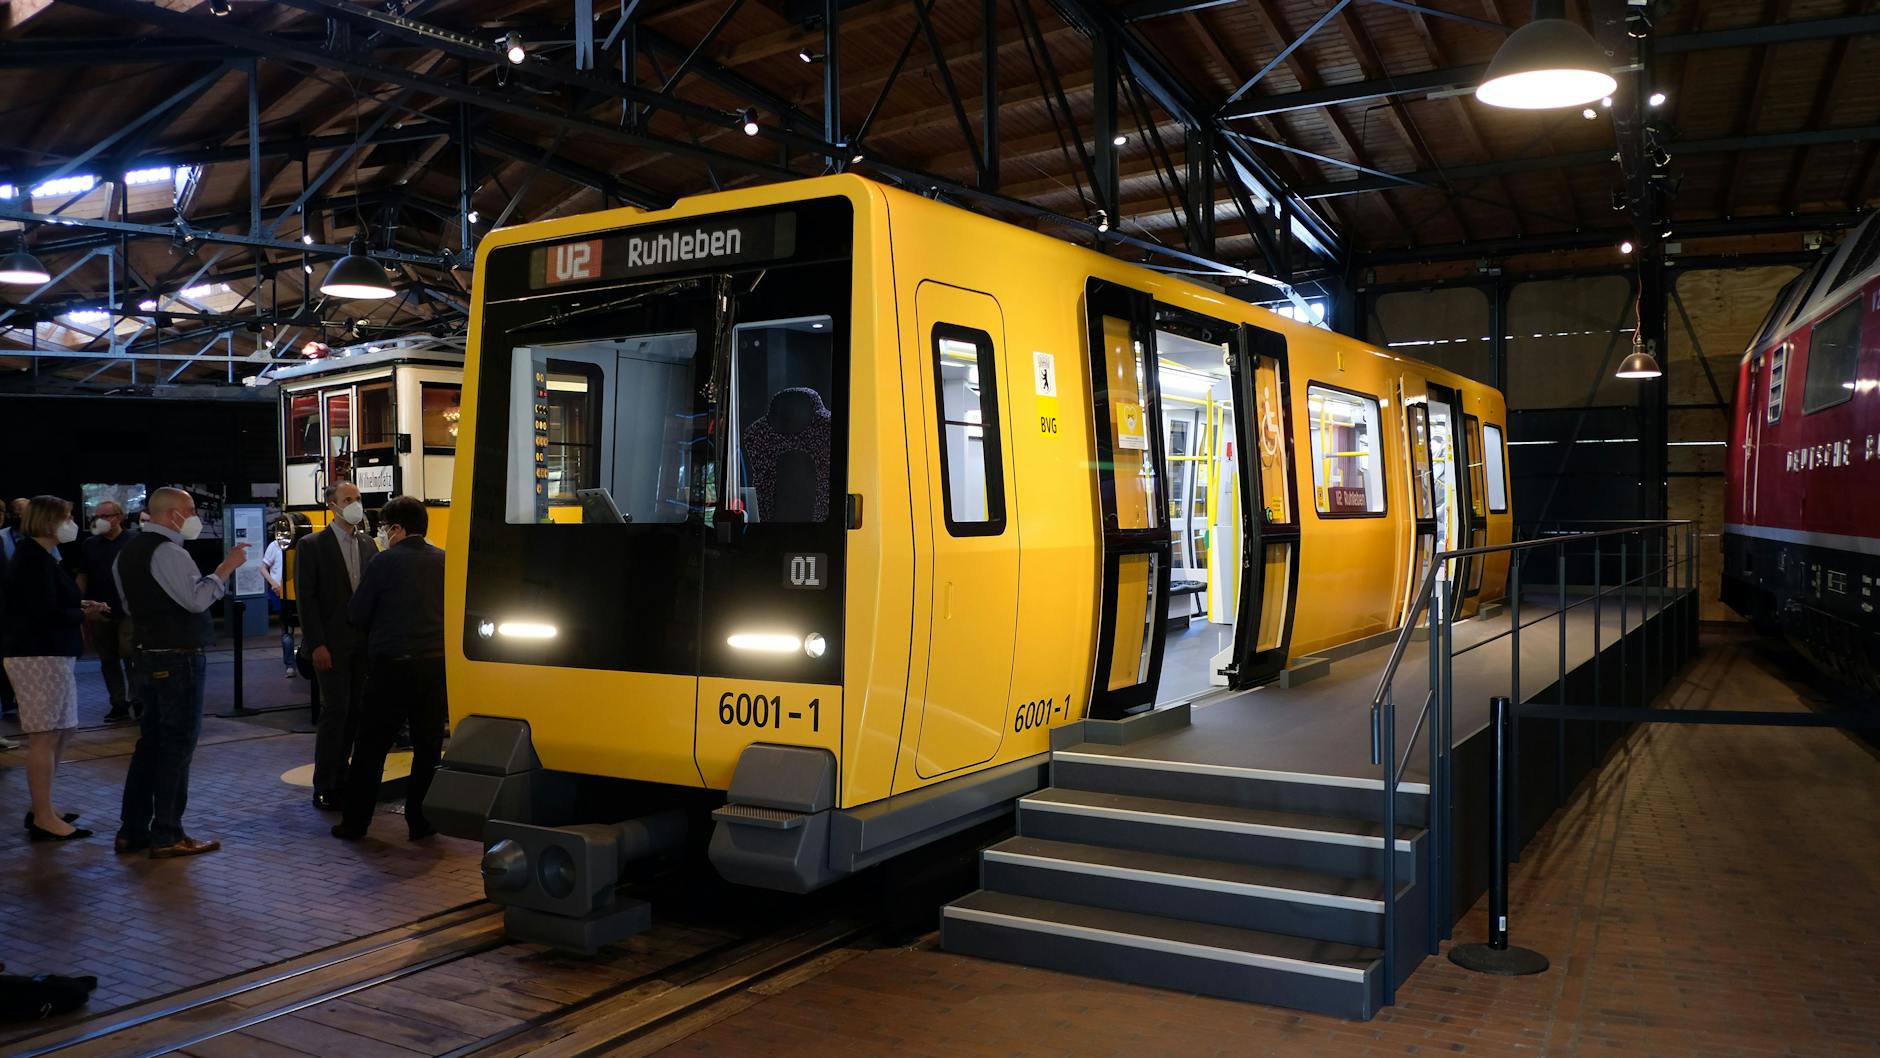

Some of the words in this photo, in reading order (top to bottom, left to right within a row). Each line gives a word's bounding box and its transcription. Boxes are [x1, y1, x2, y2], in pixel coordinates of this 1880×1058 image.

[556, 244, 591, 280] U2
[627, 229, 742, 268] Ruhleben
[1040, 416, 1057, 434] BVG
[790, 556, 820, 586] 01
[718, 692, 820, 732] 6001-1
[1014, 694, 1071, 733] 6001-1
